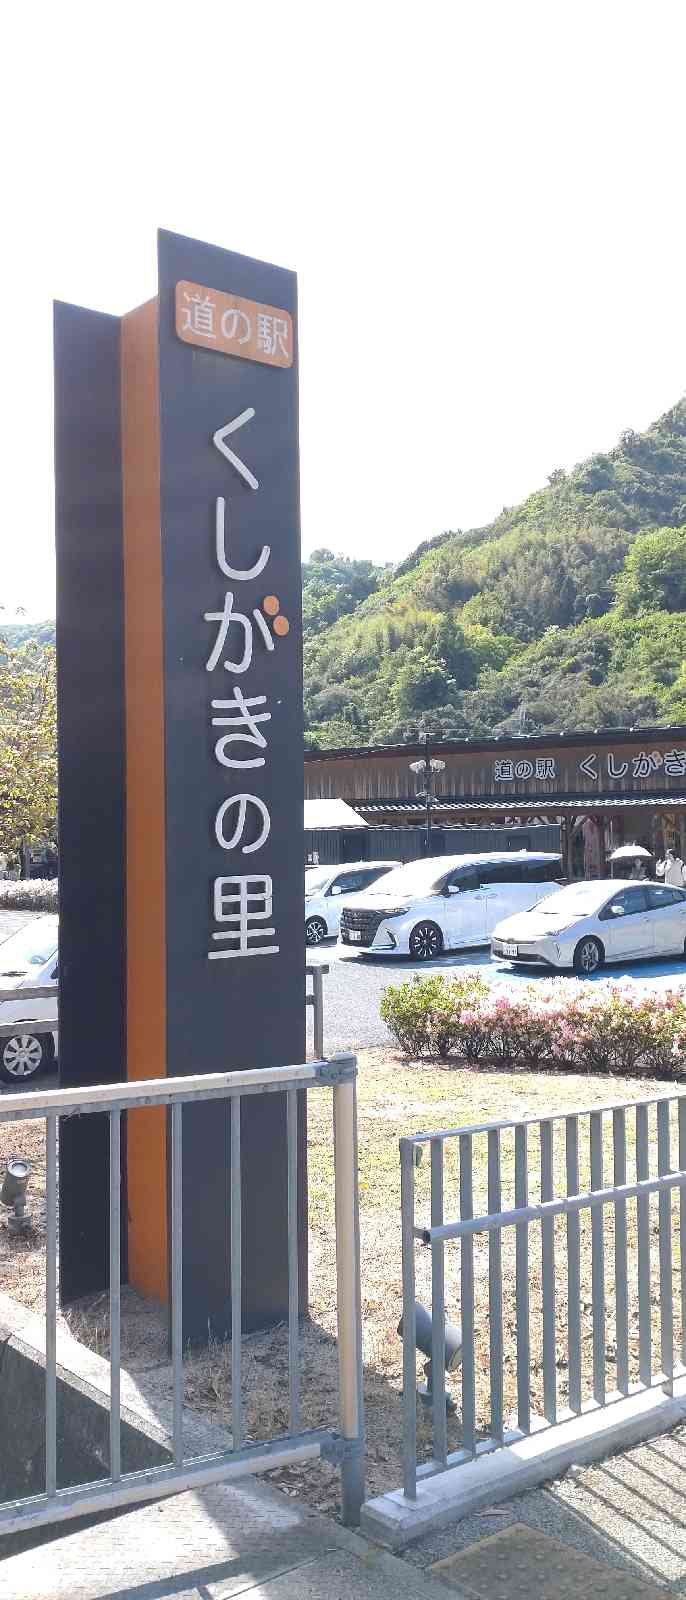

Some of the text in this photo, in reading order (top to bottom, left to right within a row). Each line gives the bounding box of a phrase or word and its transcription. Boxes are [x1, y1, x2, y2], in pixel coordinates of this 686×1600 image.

[181, 291, 289, 358] 道の駅
[205, 407, 289, 960] くしがきの里
[495, 749, 686, 781] 道の駅 くしがき
